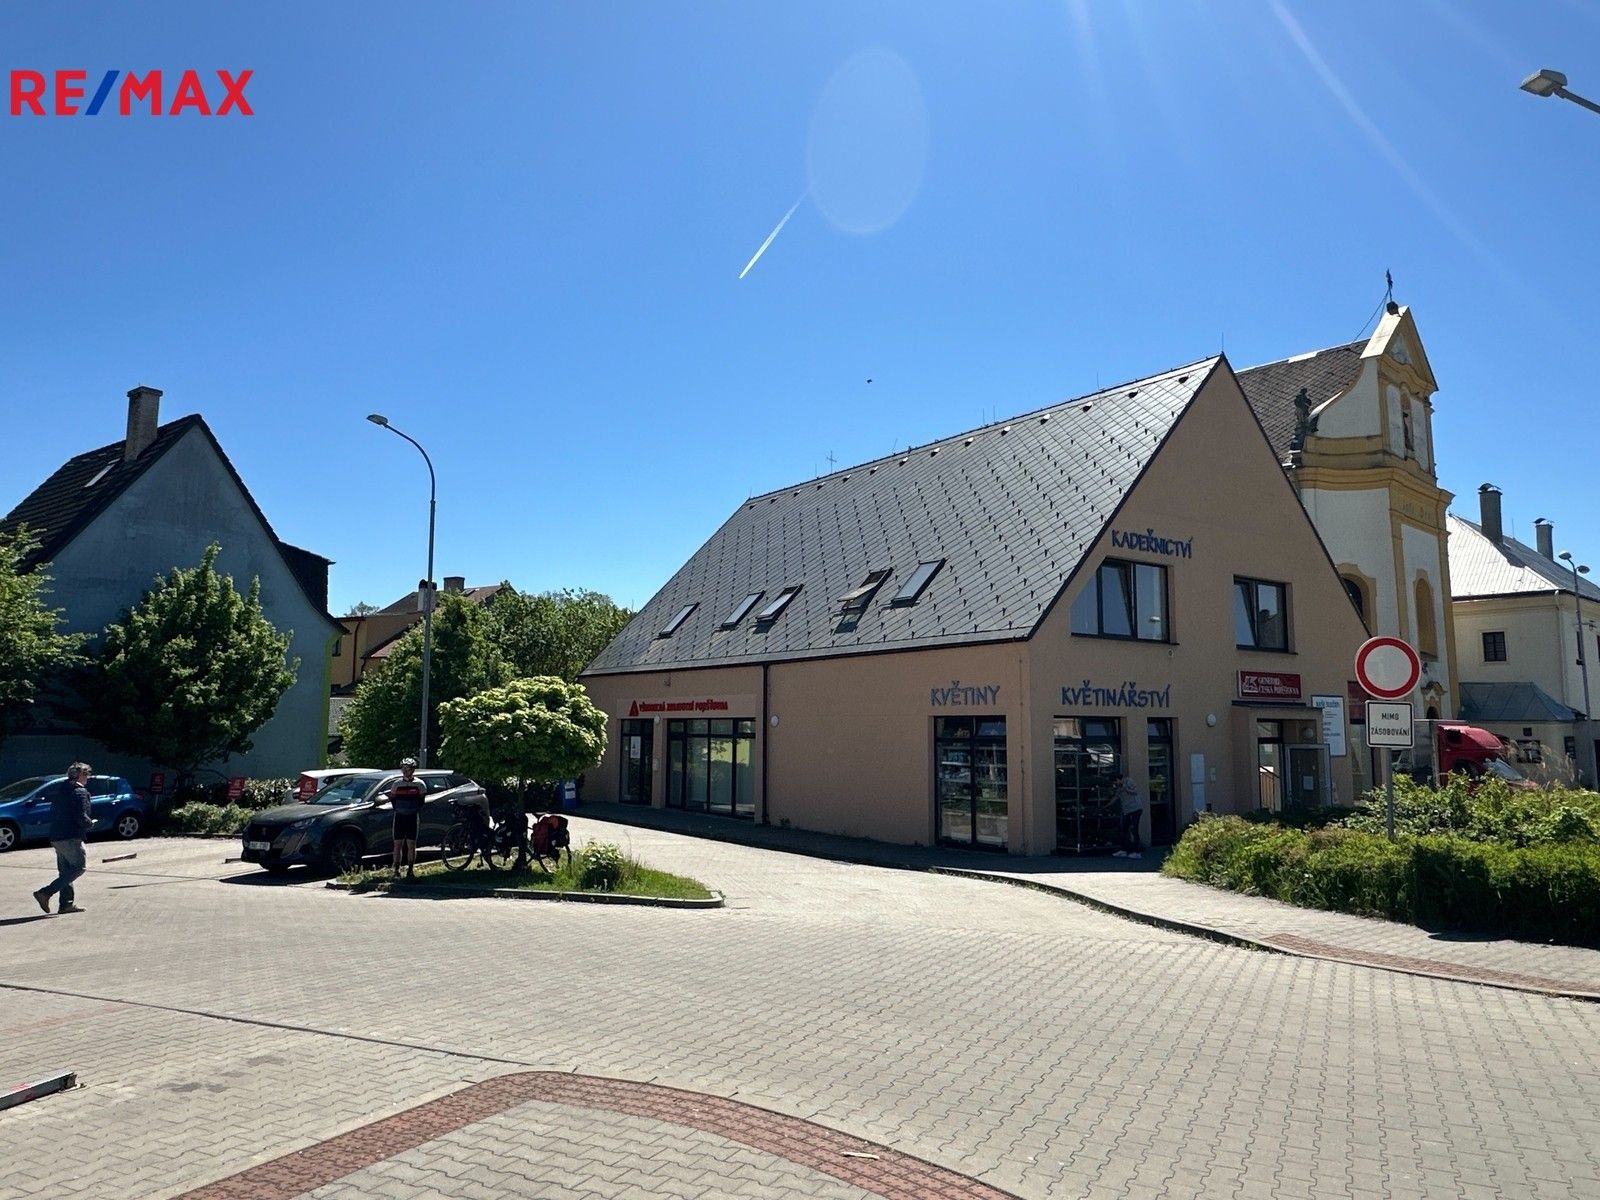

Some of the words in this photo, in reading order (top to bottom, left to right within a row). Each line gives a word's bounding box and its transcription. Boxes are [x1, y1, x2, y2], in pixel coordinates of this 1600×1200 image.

[1112, 528, 1193, 559] KADEŘNICTVÍ
[930, 680, 1000, 706] KVĚTINY
[1062, 680, 1171, 708] KVĚTINÁŘSTVÍ
[1381, 712, 1400, 720] MIMO
[1371, 727, 1410, 736] ZÁSOBOVÁNÍ
